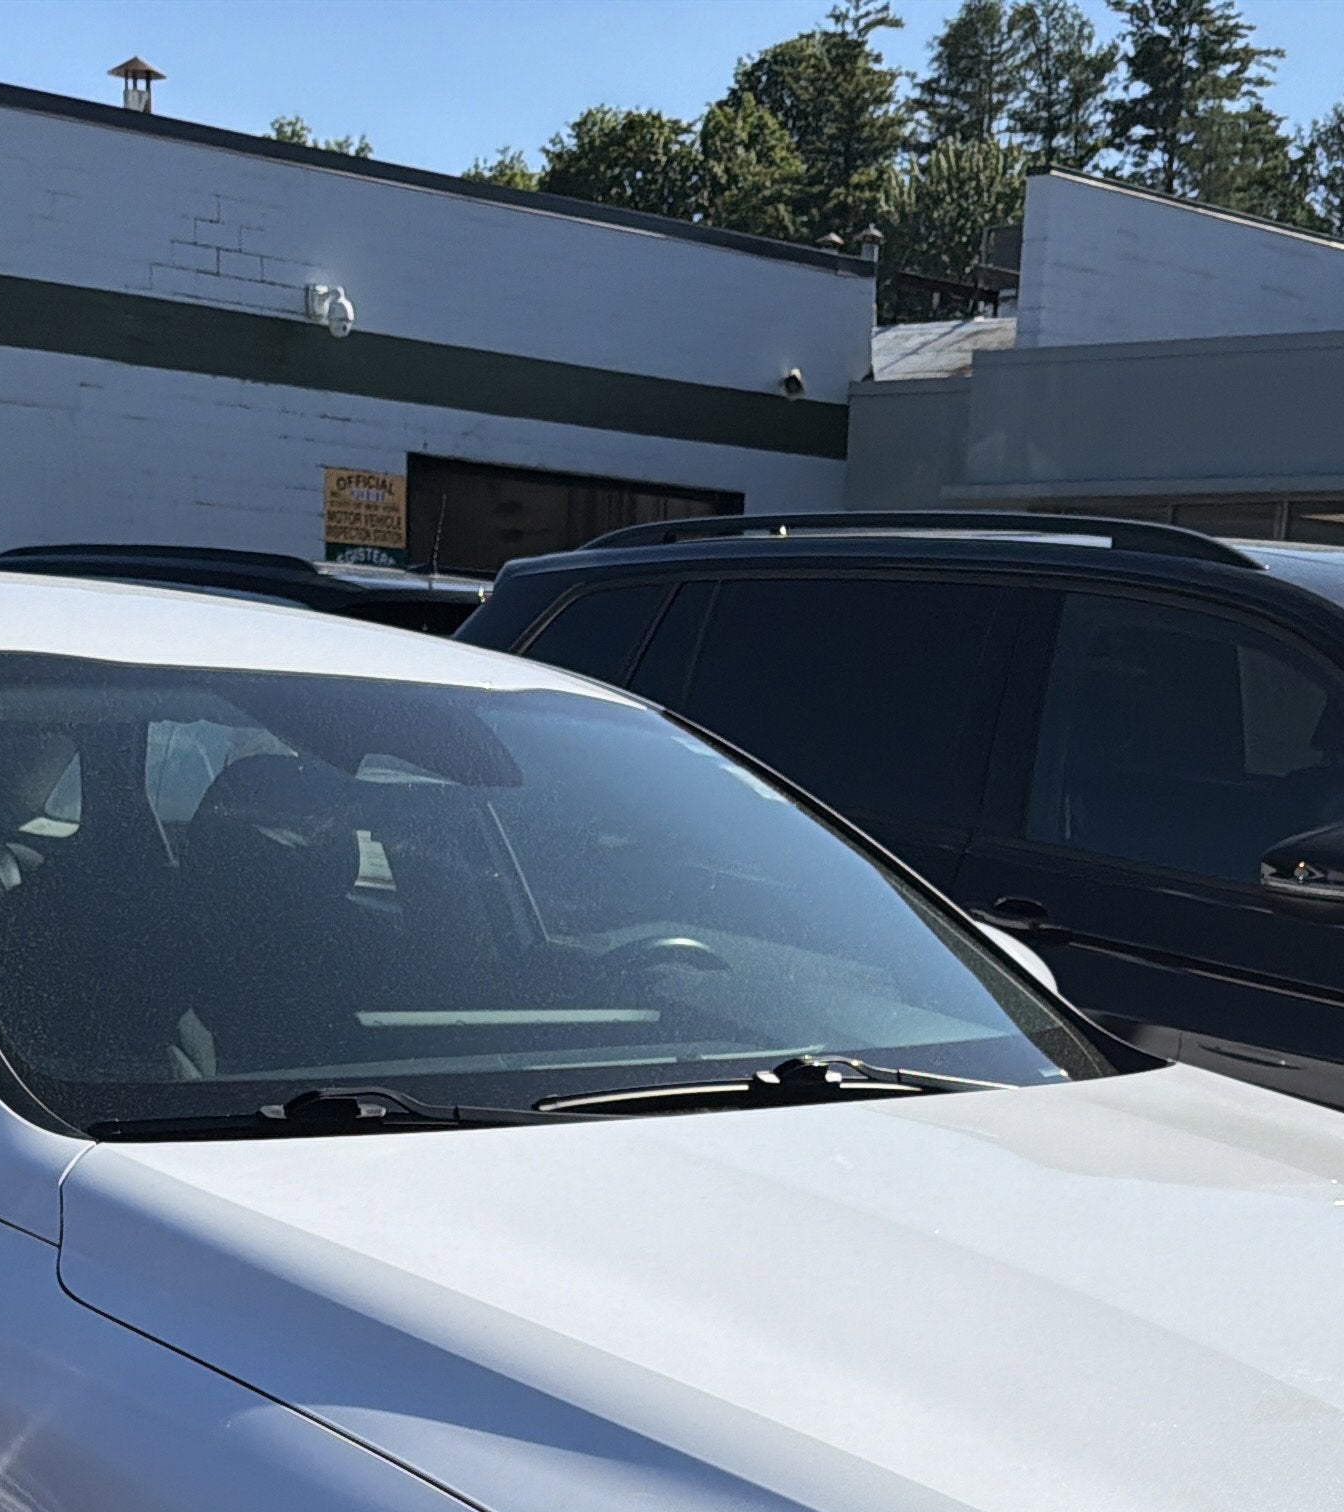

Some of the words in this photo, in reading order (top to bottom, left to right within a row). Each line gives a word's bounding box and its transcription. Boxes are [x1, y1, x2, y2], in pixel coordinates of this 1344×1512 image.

[336, 474, 394, 496] OFFICIAL
[327, 510, 362, 526] MOTOR
[364, 513, 402, 531] VEHICLE
